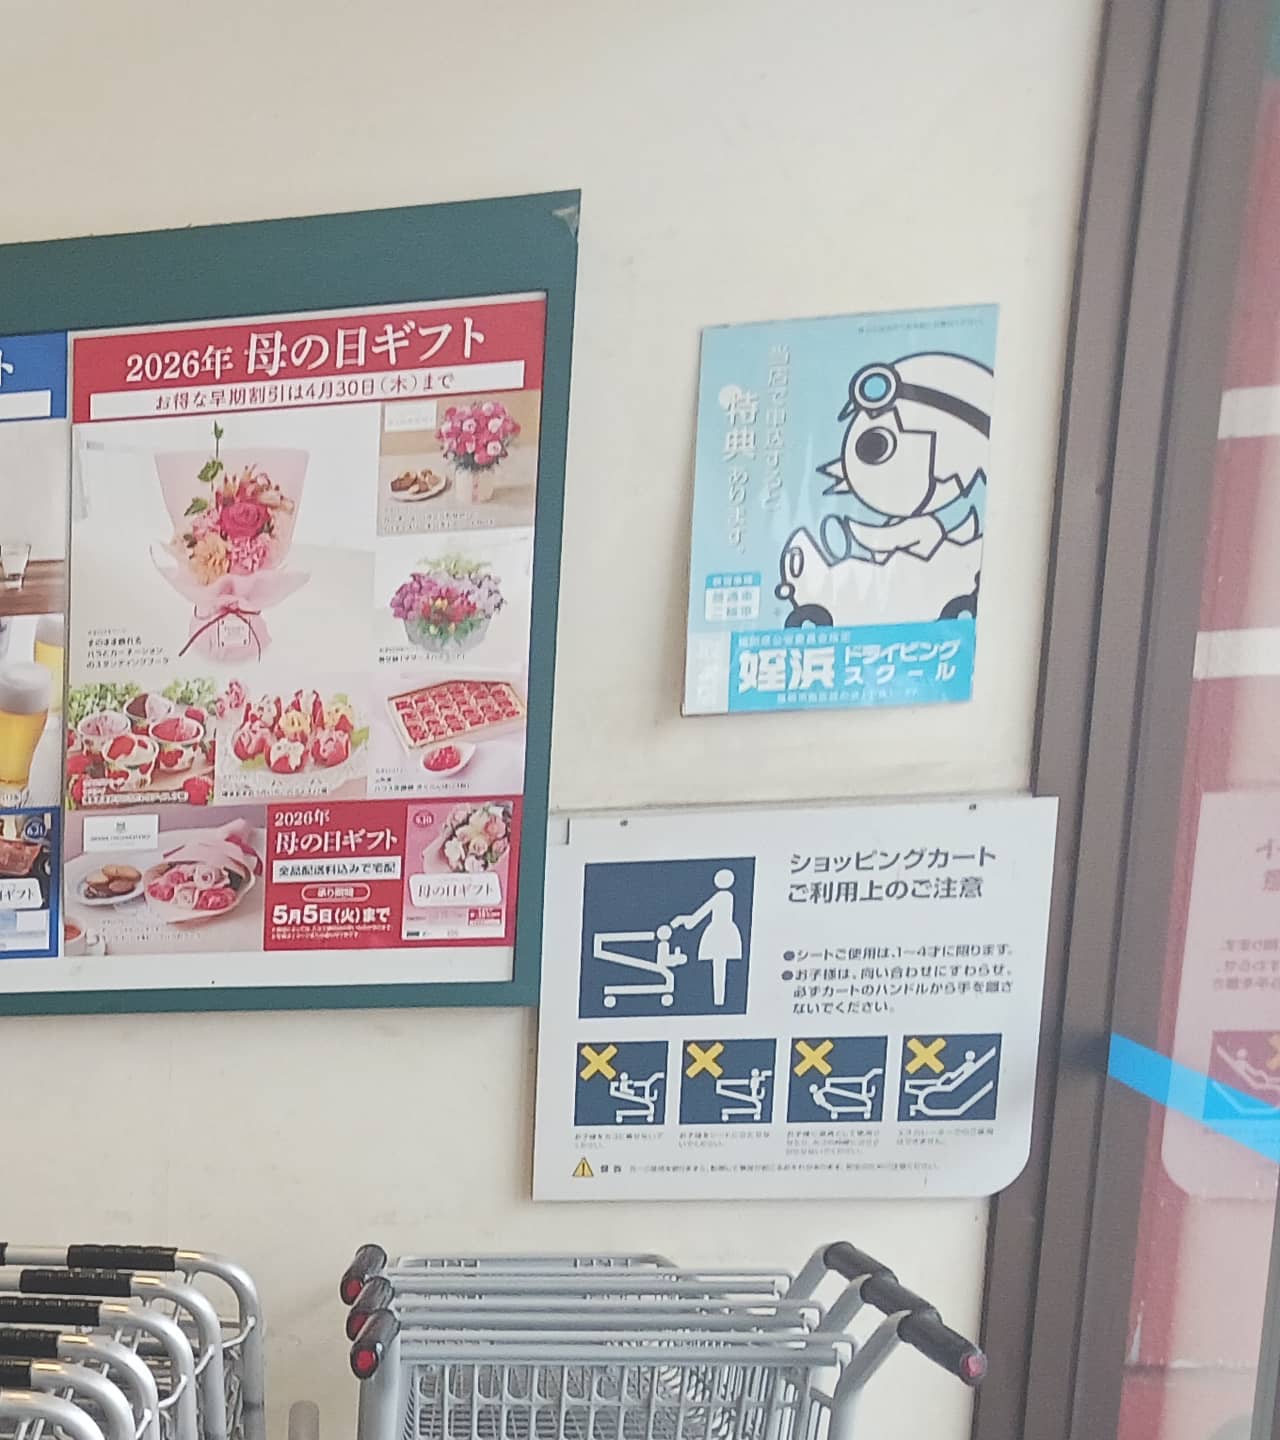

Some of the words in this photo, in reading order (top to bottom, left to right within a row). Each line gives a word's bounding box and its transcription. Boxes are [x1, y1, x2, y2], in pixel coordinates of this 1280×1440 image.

[126, 345, 233, 383] 2026年
[244, 317, 486, 376] 母の日ギフト
[845, 640, 960, 664] ドライビング
[738, 646, 836, 693] 姪浜
[845, 664, 957, 685] スクール
[274, 808, 330, 827] 2026年
[276, 828, 398, 855] 母の日ギフト
[790, 846, 996, 874] ショッピングカート
[788, 876, 983, 904] ご利用上のご注意
